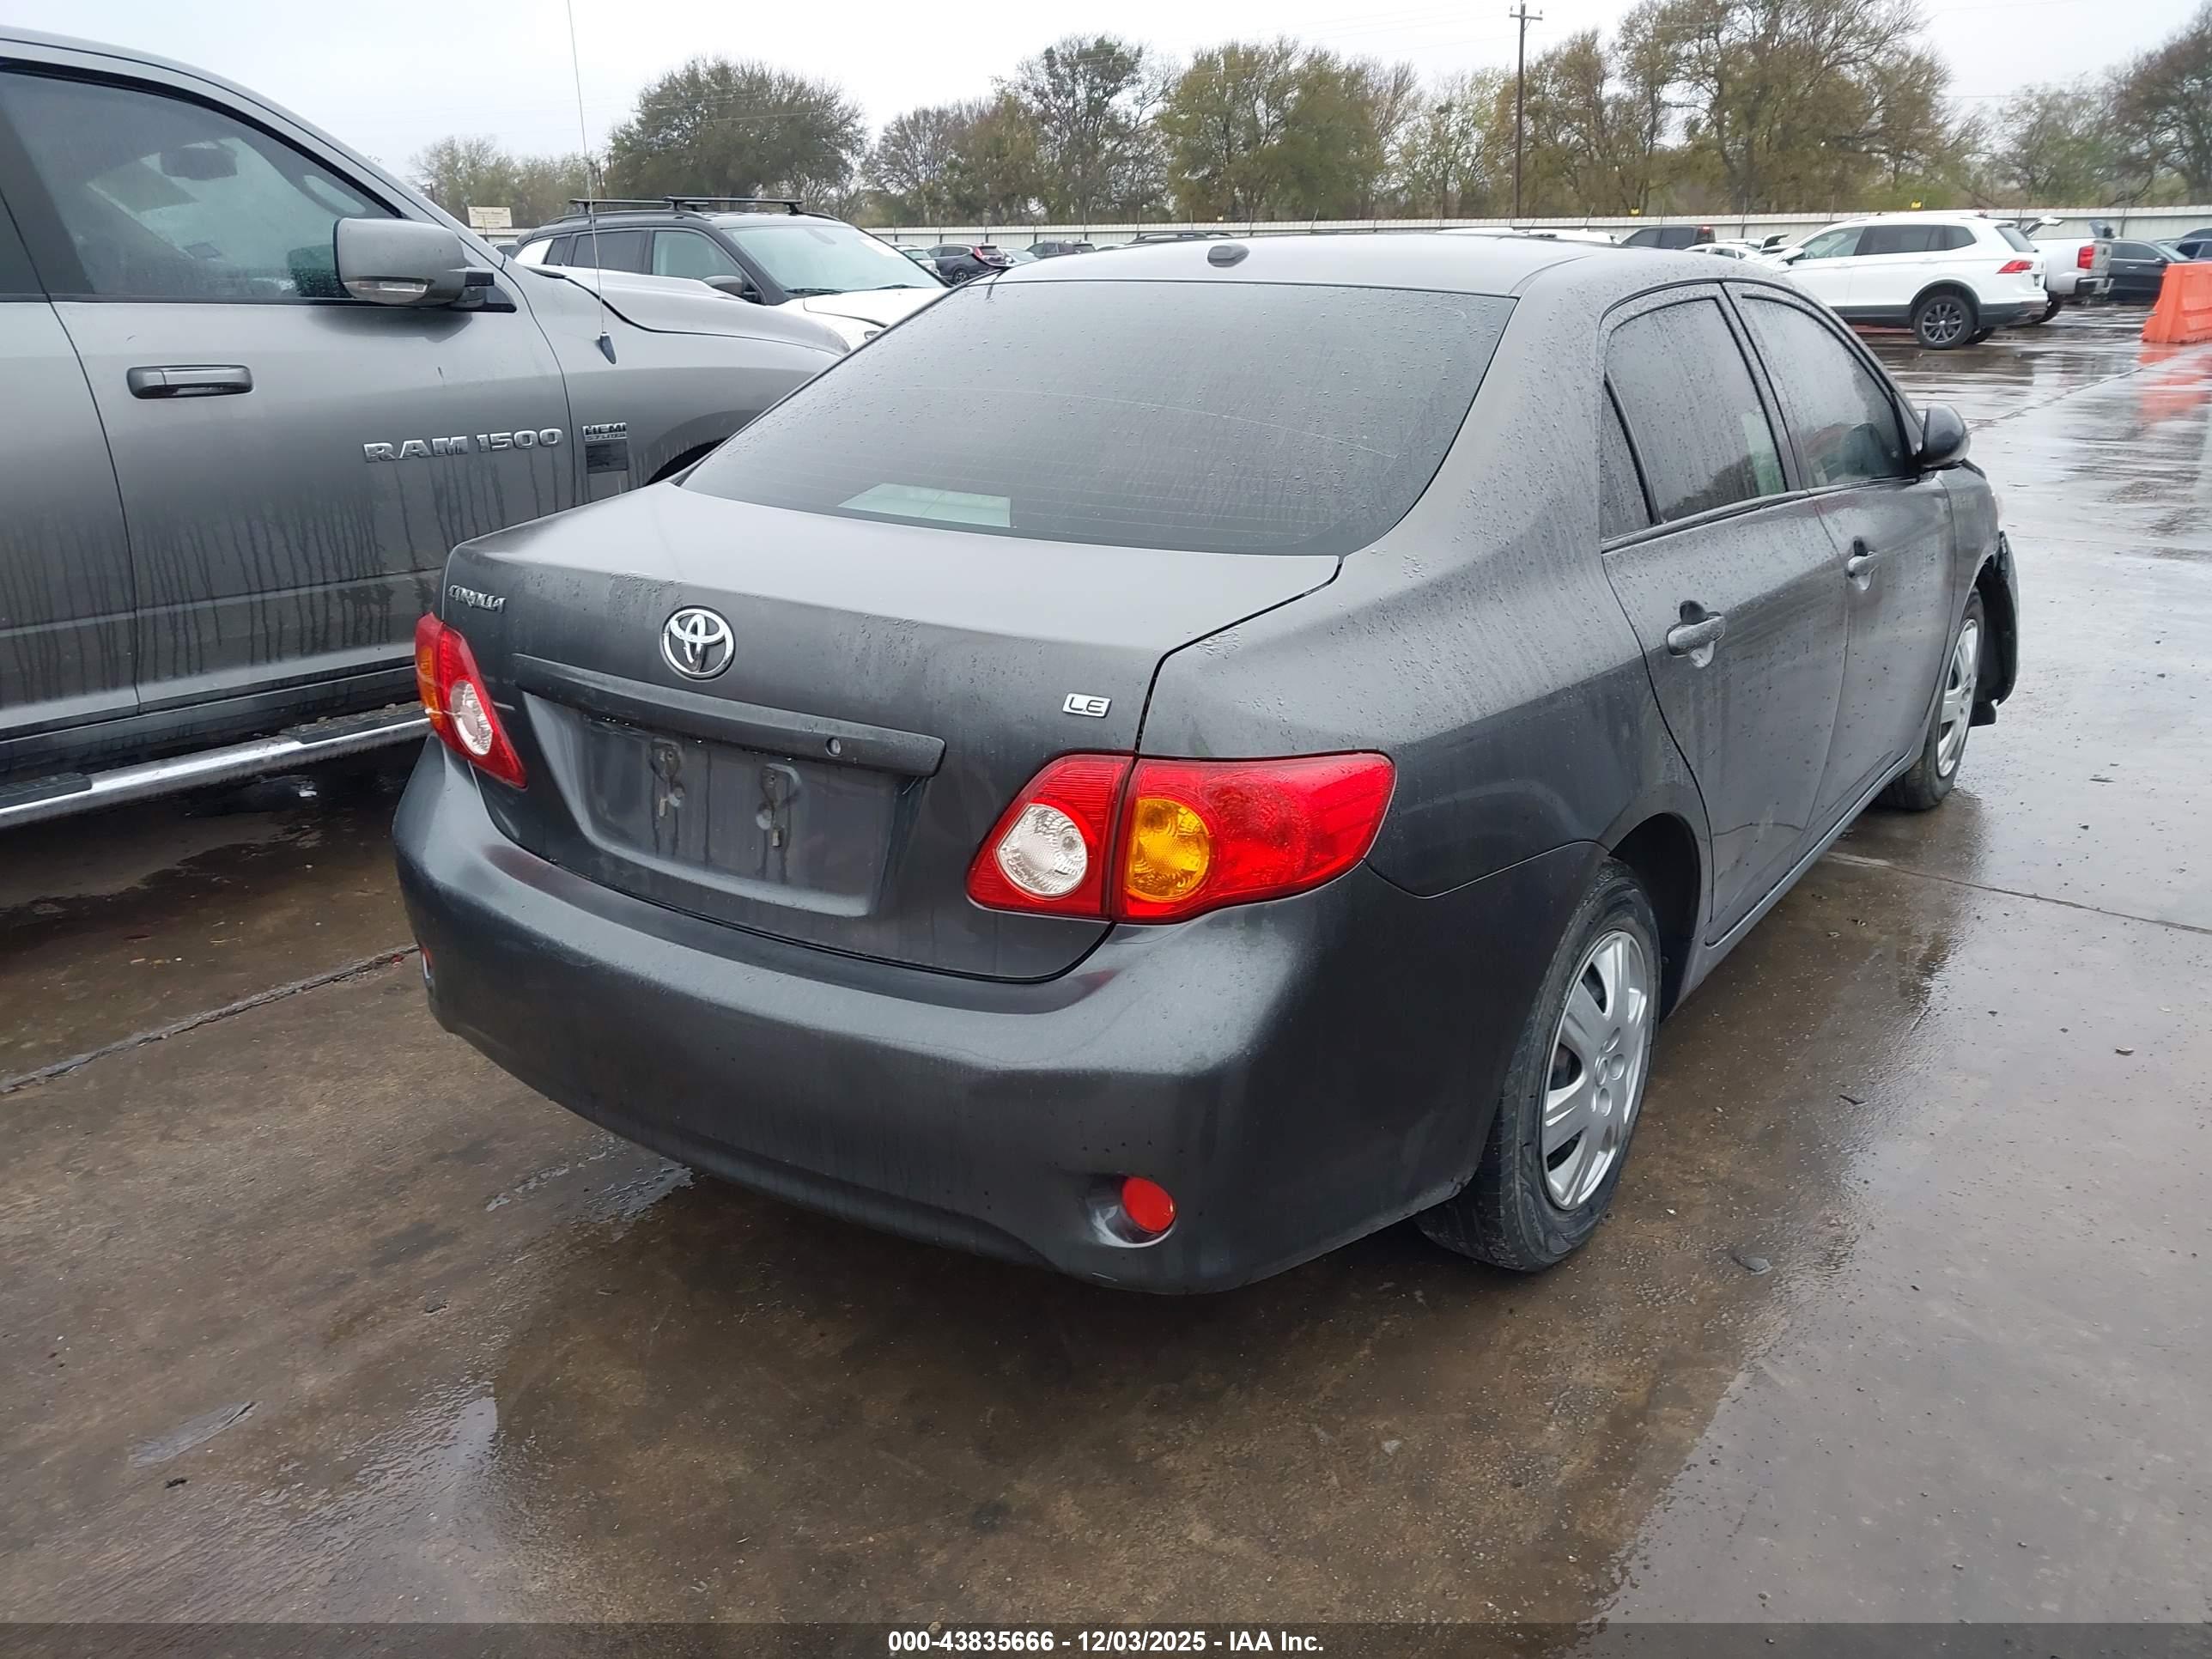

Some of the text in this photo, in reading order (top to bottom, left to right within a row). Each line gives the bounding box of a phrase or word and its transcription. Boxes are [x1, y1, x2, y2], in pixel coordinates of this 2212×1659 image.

[582, 422, 627, 435] HEMI
[364, 428, 564, 463] RAM 1500
[1068, 696, 1105, 714] LE
